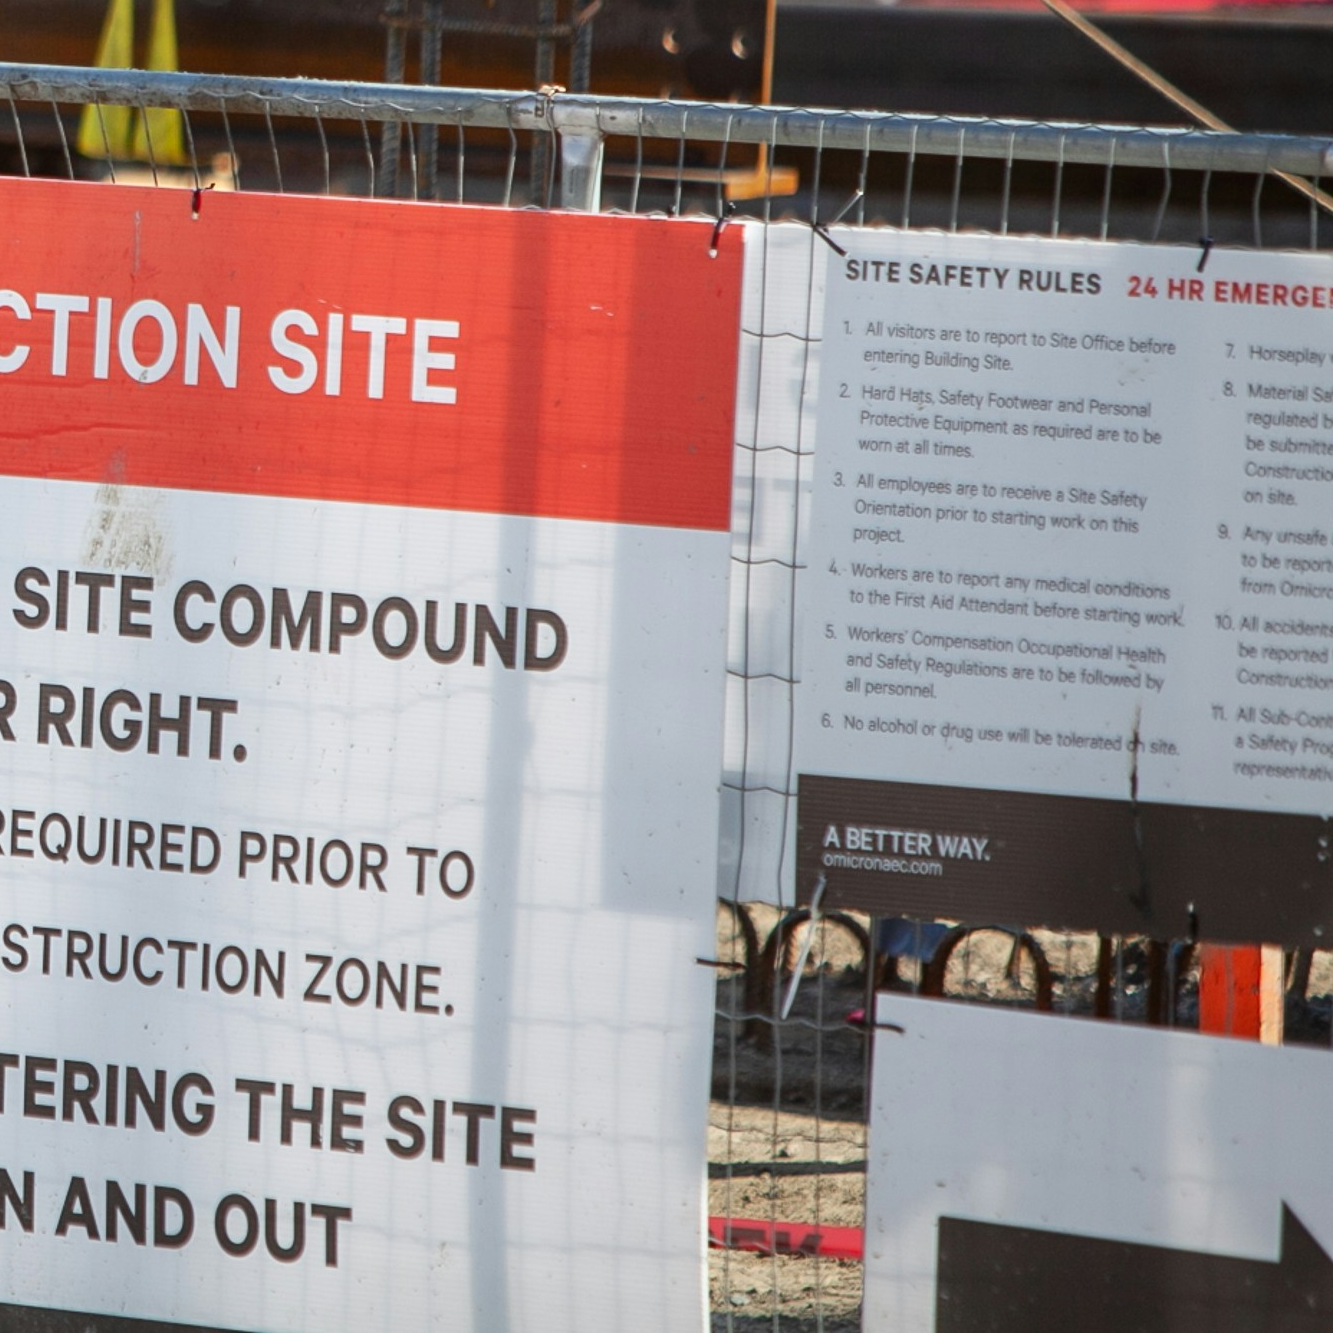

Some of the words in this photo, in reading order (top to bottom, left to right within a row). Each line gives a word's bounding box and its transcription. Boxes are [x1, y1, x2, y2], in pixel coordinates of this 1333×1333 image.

[845, 258, 901, 284] SITE
[908, 262, 1010, 290] SAFETY
[1018, 268, 1102, 296] RULES
[1127, 274, 1159, 299] 24
[1167, 277, 1205, 302] HR
[1214, 279, 1333, 309] EMERGE
[267, 307, 460, 405] SITE
[843, 320, 853, 335] 1.
[865, 320, 884, 337] All
[886, 322, 937, 341] visitors
[939, 328, 962, 343] are
[964, 328, 981, 343] to
[983, 331, 1028, 348] report
[1030, 332, 1047, 348] to
[1049, 331, 1078, 350] Site
[1080, 333, 1126, 352] Office
[1128, 336, 1177, 356] before
[863, 348, 921, 369] entering
[924, 350, 980, 374] Building
[982, 353, 1014, 371] Site.
[838, 382, 851, 399] 2.
[861, 384, 896, 402] Hard
[899, 387, 936, 407] Hats,
[938, 388, 985, 411] Safety
[987, 391, 1054, 412] Footwear
[1056, 397, 1085, 414] and
[1088, 397, 1152, 419] Personal
[859, 409, 931, 430] Protective
[932, 413, 1009, 436] Equipment
[1011, 422, 1029, 436] as
[1032, 423, 1093, 442] required
[1095, 428, 1121, 443] are
[1122, 428, 1140, 444] to
[1142, 427, 1163, 445] be
[857, 439, 893, 453] worn
[894, 439, 910, 455] at
[913, 438, 930, 456] all
[932, 440, 975, 459] times.
[832, 470, 846, 488] 3.
[855, 472, 875, 489] All
[876, 475, 953, 497] employees
[955, 482, 979, 497] are
[981, 482, 998, 499] to
[1000, 484, 1053, 502] receive
[1055, 489, 1065, 503] a
[1067, 487, 1097, 505] Site
[1099, 488, 1148, 511] Safety
[853, 498, 932, 519] Orientation
[935, 504, 969, 523] prior
[971, 508, 988, 523] to
[990, 509, 1047, 531] starting
[1049, 513, 1086, 530] work
[1088, 517, 1109, 531] on
[1111, 516, 1140, 534] this
[852, 526, 905, 546] project.
[828, 558, 841, 576] 4.
[850, 561, 909, 582] Workers
[911, 569, 935, 584] are
[937, 568, 954, 585] to
[956, 572, 1001, 590] report
[1003, 575, 1031, 594] any
[1034, 575, 1091, 595] medical
[1093, 580, 1171, 601] conditions
[12, 566, 155, 639] SITE
[172, 578, 569, 672] COMPOUND
[849, 589, 865, 604] to
[867, 588, 891, 606] the
[894, 590, 926, 609] First
[929, 593, 955, 611] Aid
[957, 595, 1029, 617] Attendant
[1032, 600, 1081, 620] before
[1083, 606, 1142, 628] starting
[1144, 605, 1185, 627] work.
[36, 682, 248, 763] RIGHT.
[823, 824, 841, 849] A
[845, 825, 933, 857] BETTER
[936, 833, 991, 862] WAY.
[238, 830, 389, 892] PRIOR
[406, 845, 475, 900] TO
[303, 952, 455, 1017] ZONE.
[234, 1077, 367, 1154] THE
[385, 1094, 537, 1173] SITE
[54, 1175, 195, 1250] AND
[213, 1192, 353, 1268] OUT
